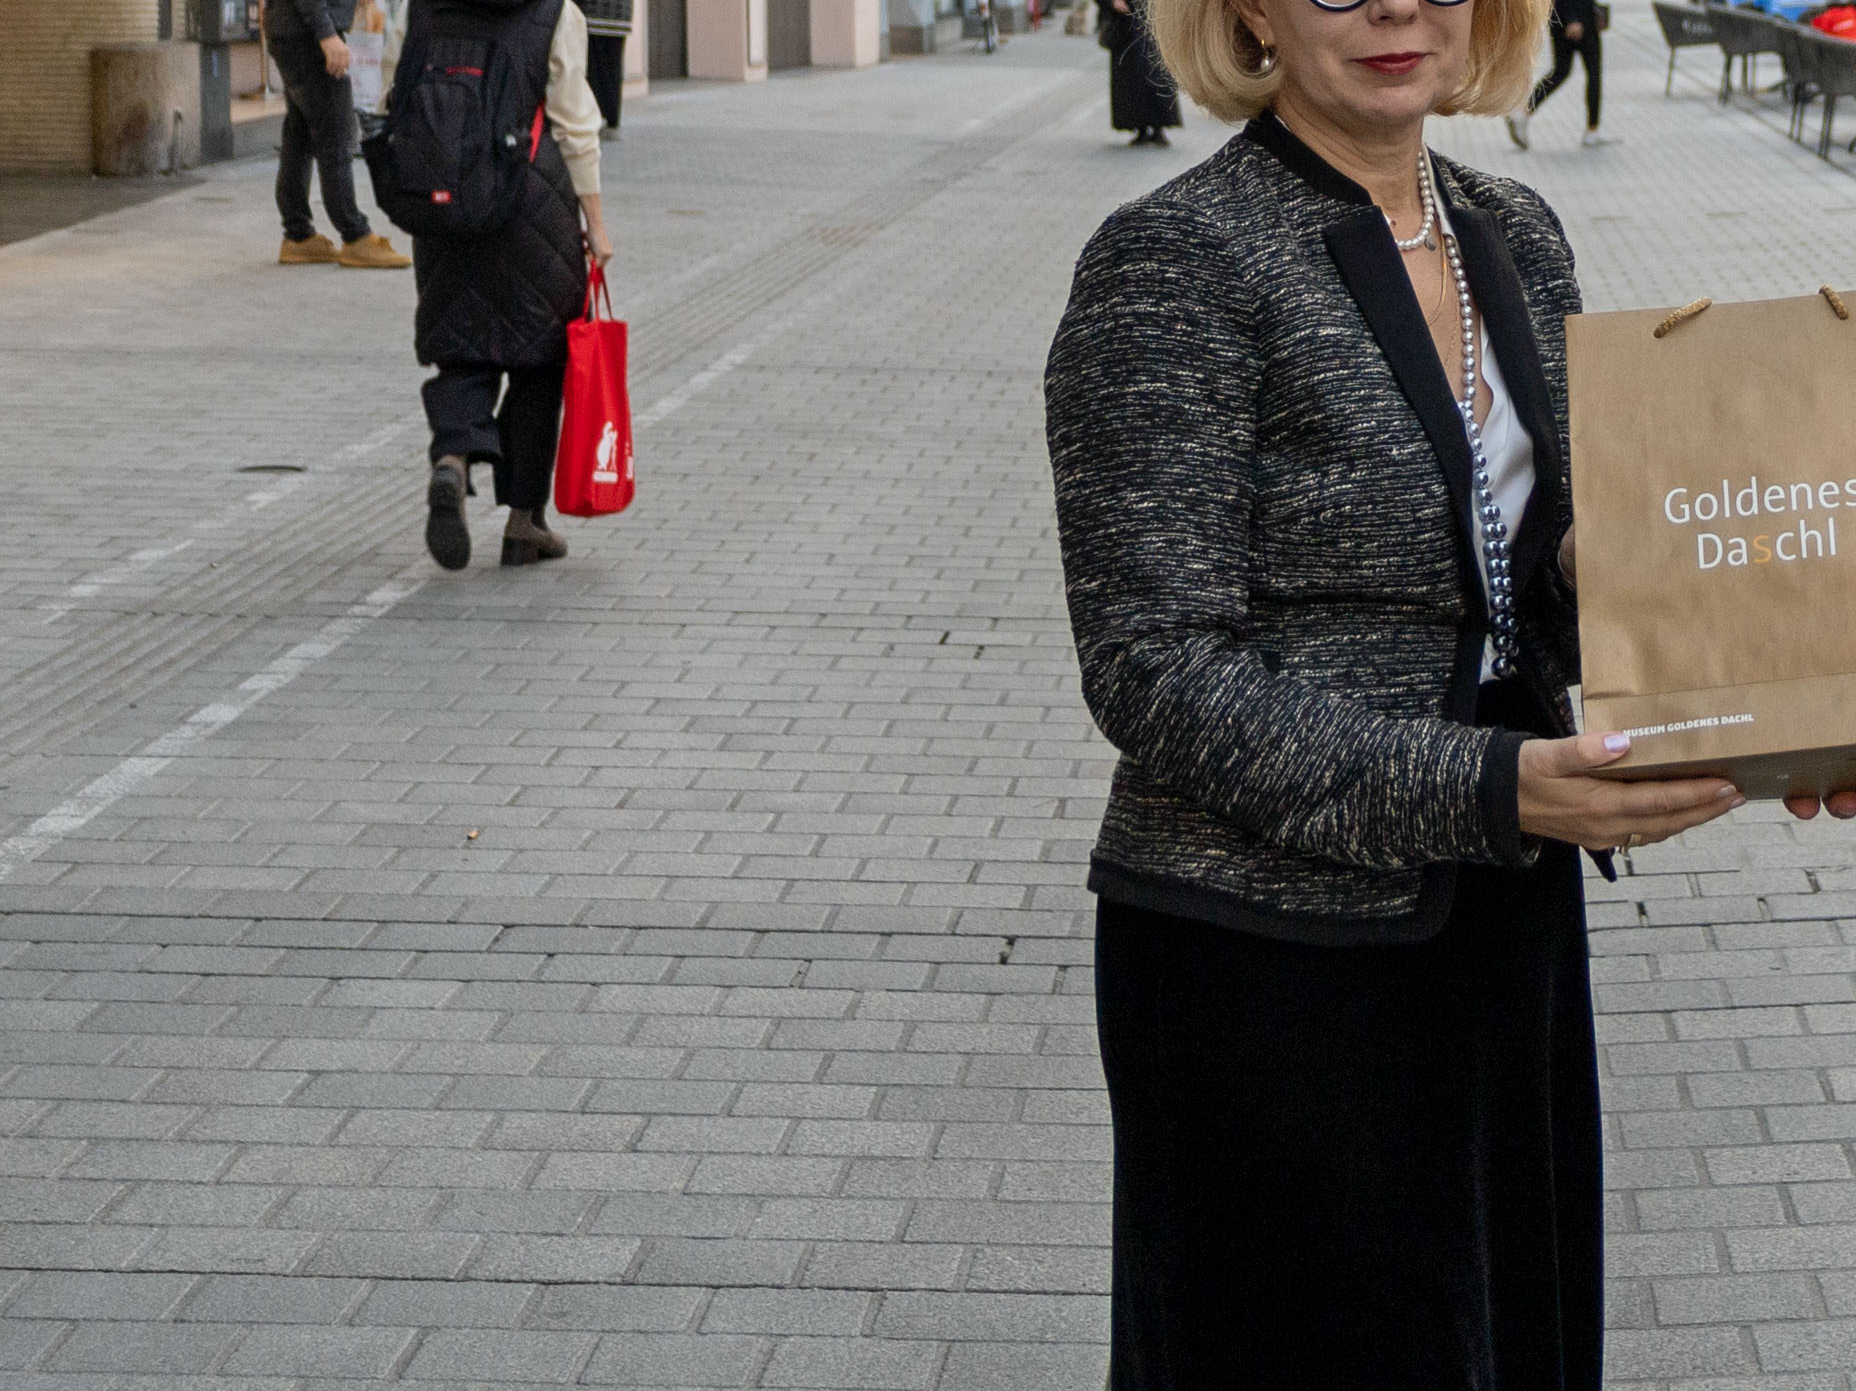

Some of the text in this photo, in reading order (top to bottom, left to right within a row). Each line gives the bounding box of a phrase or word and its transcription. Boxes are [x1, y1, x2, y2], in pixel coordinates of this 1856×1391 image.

[1697, 516, 1837, 570] Daschl
[1623, 712, 1755, 738] MUSEUM GOLDENES DACHL
